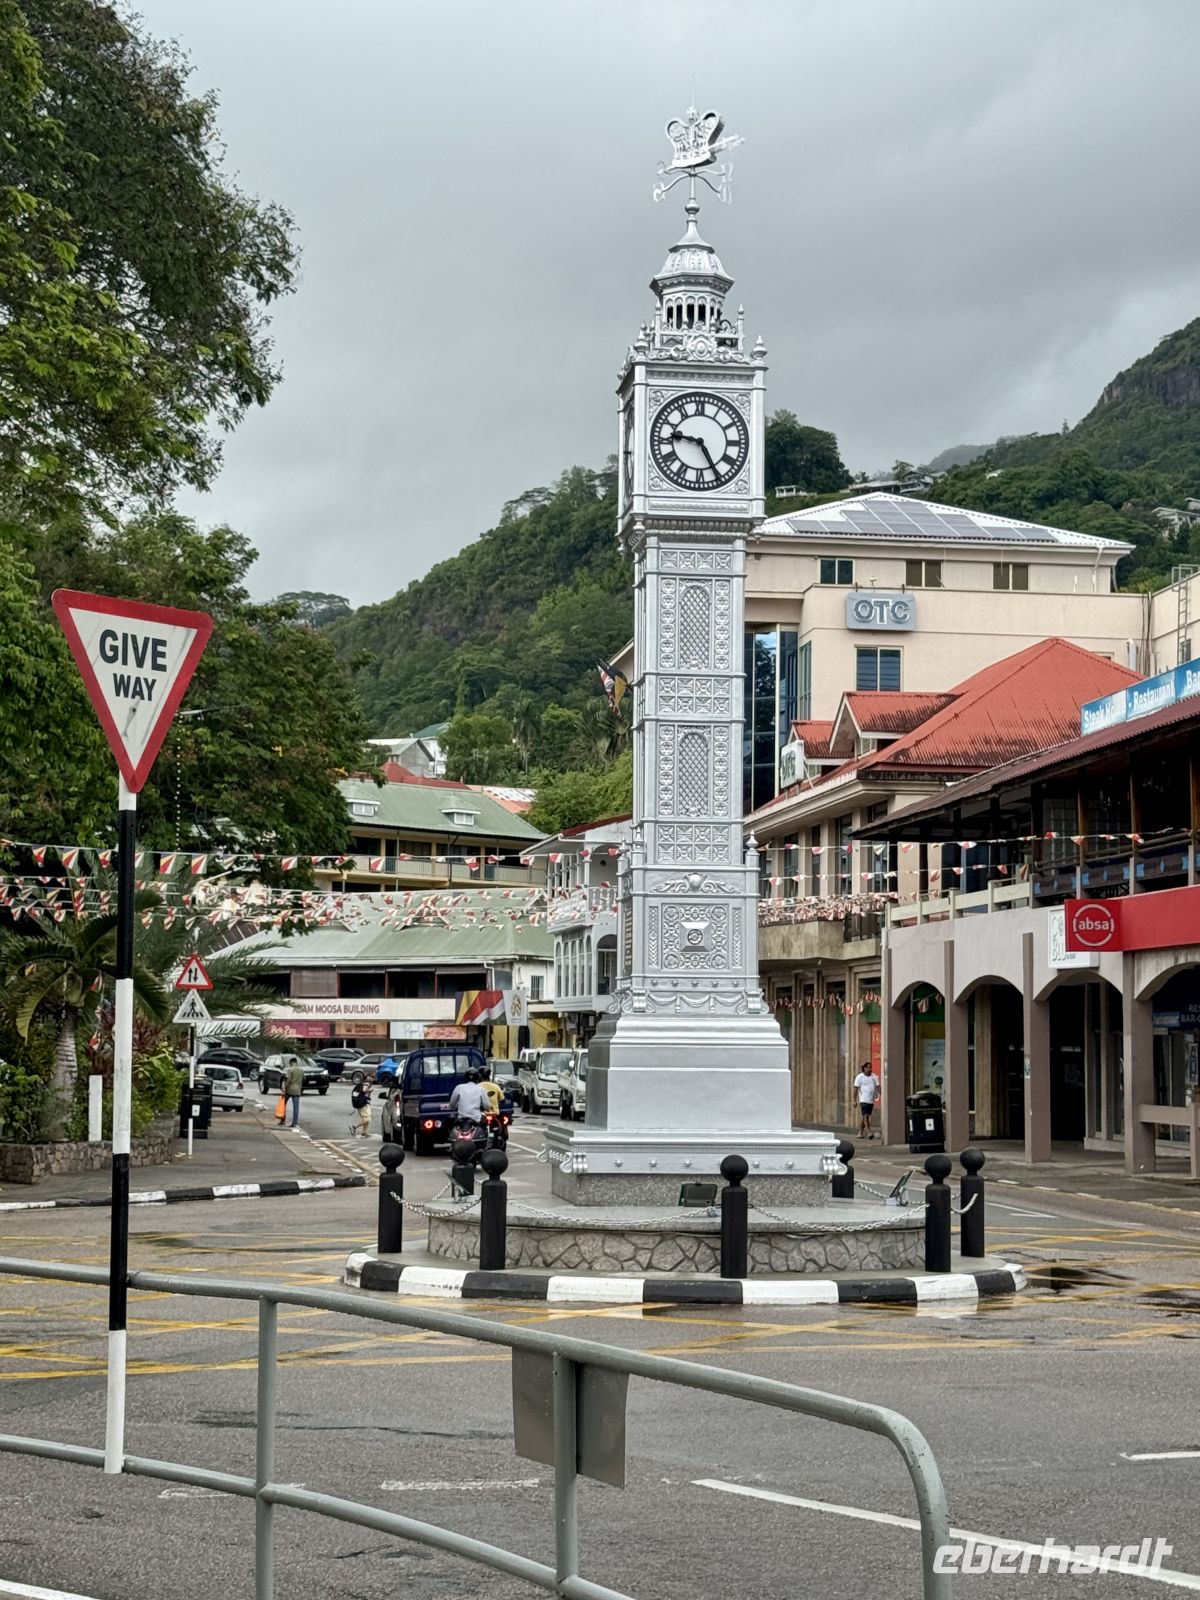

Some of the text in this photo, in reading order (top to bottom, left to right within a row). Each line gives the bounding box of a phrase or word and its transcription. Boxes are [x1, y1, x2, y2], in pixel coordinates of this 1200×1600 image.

[854, 599, 909, 624] OTC
[100, 629, 167, 672] GIVE
[113, 673, 156, 701] WAY
[1084, 704, 1103, 728] Steak
[1078, 917, 1109, 930] absa
[315, 1004, 342, 1014] MOOSA
[343, 1004, 380, 1014] BUILDING
